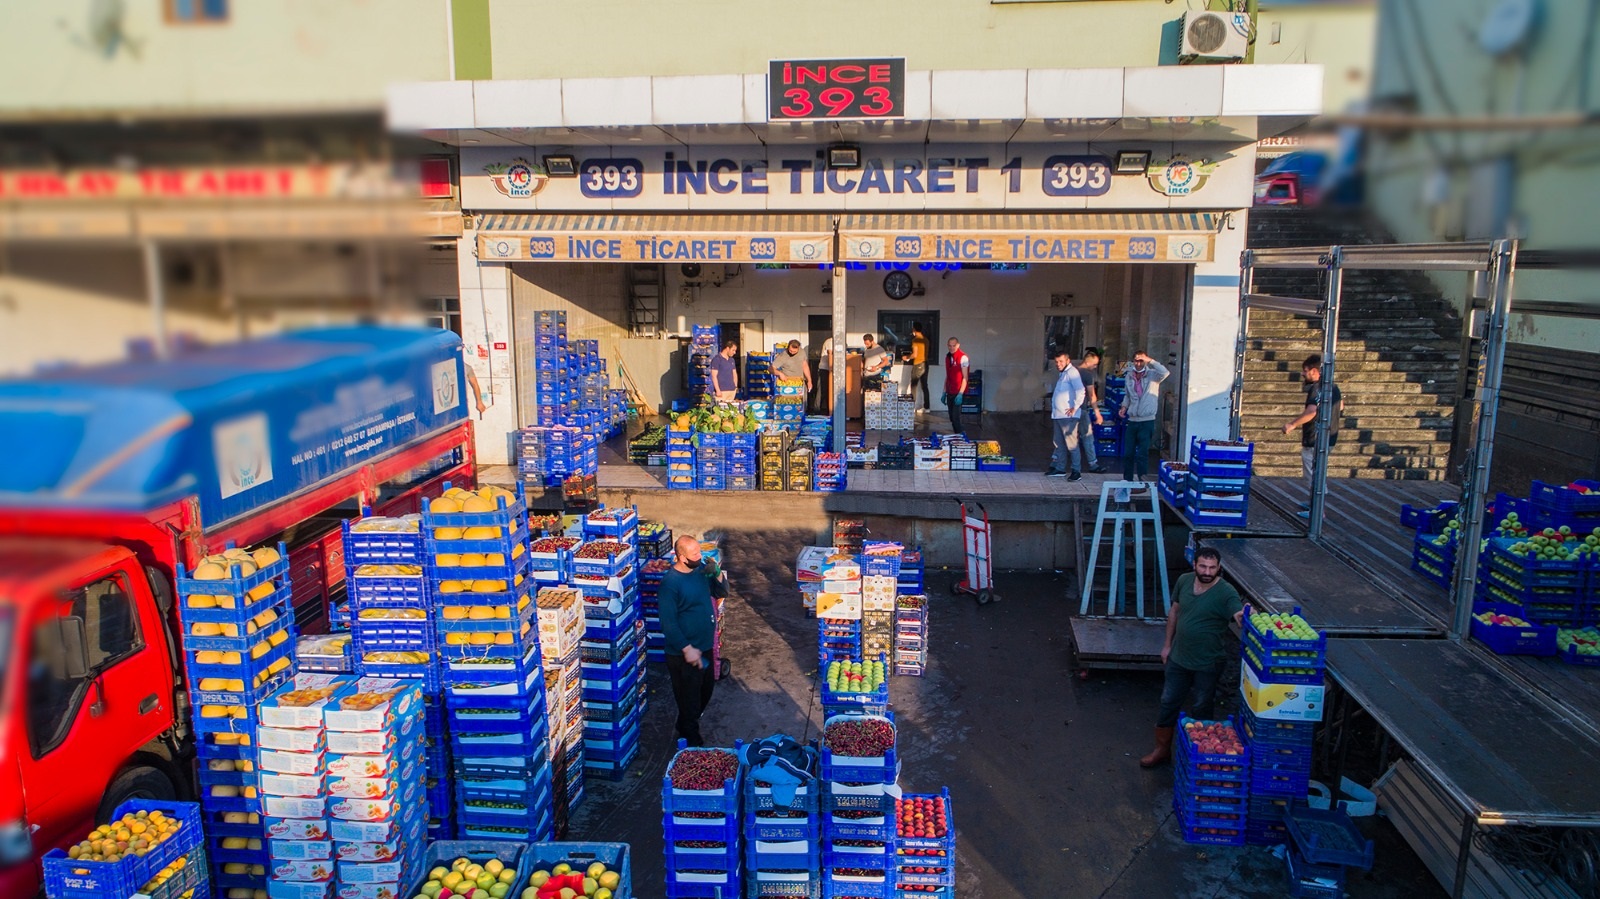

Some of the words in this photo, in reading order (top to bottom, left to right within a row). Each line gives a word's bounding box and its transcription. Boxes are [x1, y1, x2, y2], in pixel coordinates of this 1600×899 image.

[783, 62, 891, 85] İNCE
[780, 86, 894, 117] 393
[586, 165, 639, 192] 393
[663, 151, 769, 195] İNCE
[782, 149, 989, 195] TİCARET
[1001, 156, 1023, 194] 1
[1050, 162, 1107, 190] 393
[510, 187, 531, 196] ince
[1168, 185, 1190, 194] ince
[530, 239, 555, 254] 393
[568, 235, 622, 260] İNCE
[636, 235, 737, 260] TİCARET
[750, 239, 775, 256] 393
[895, 238, 922, 255] 393
[936, 234, 993, 260] İNCE
[1008, 234, 1116, 260] TİCARET
[1128, 239, 1155, 256] 393
